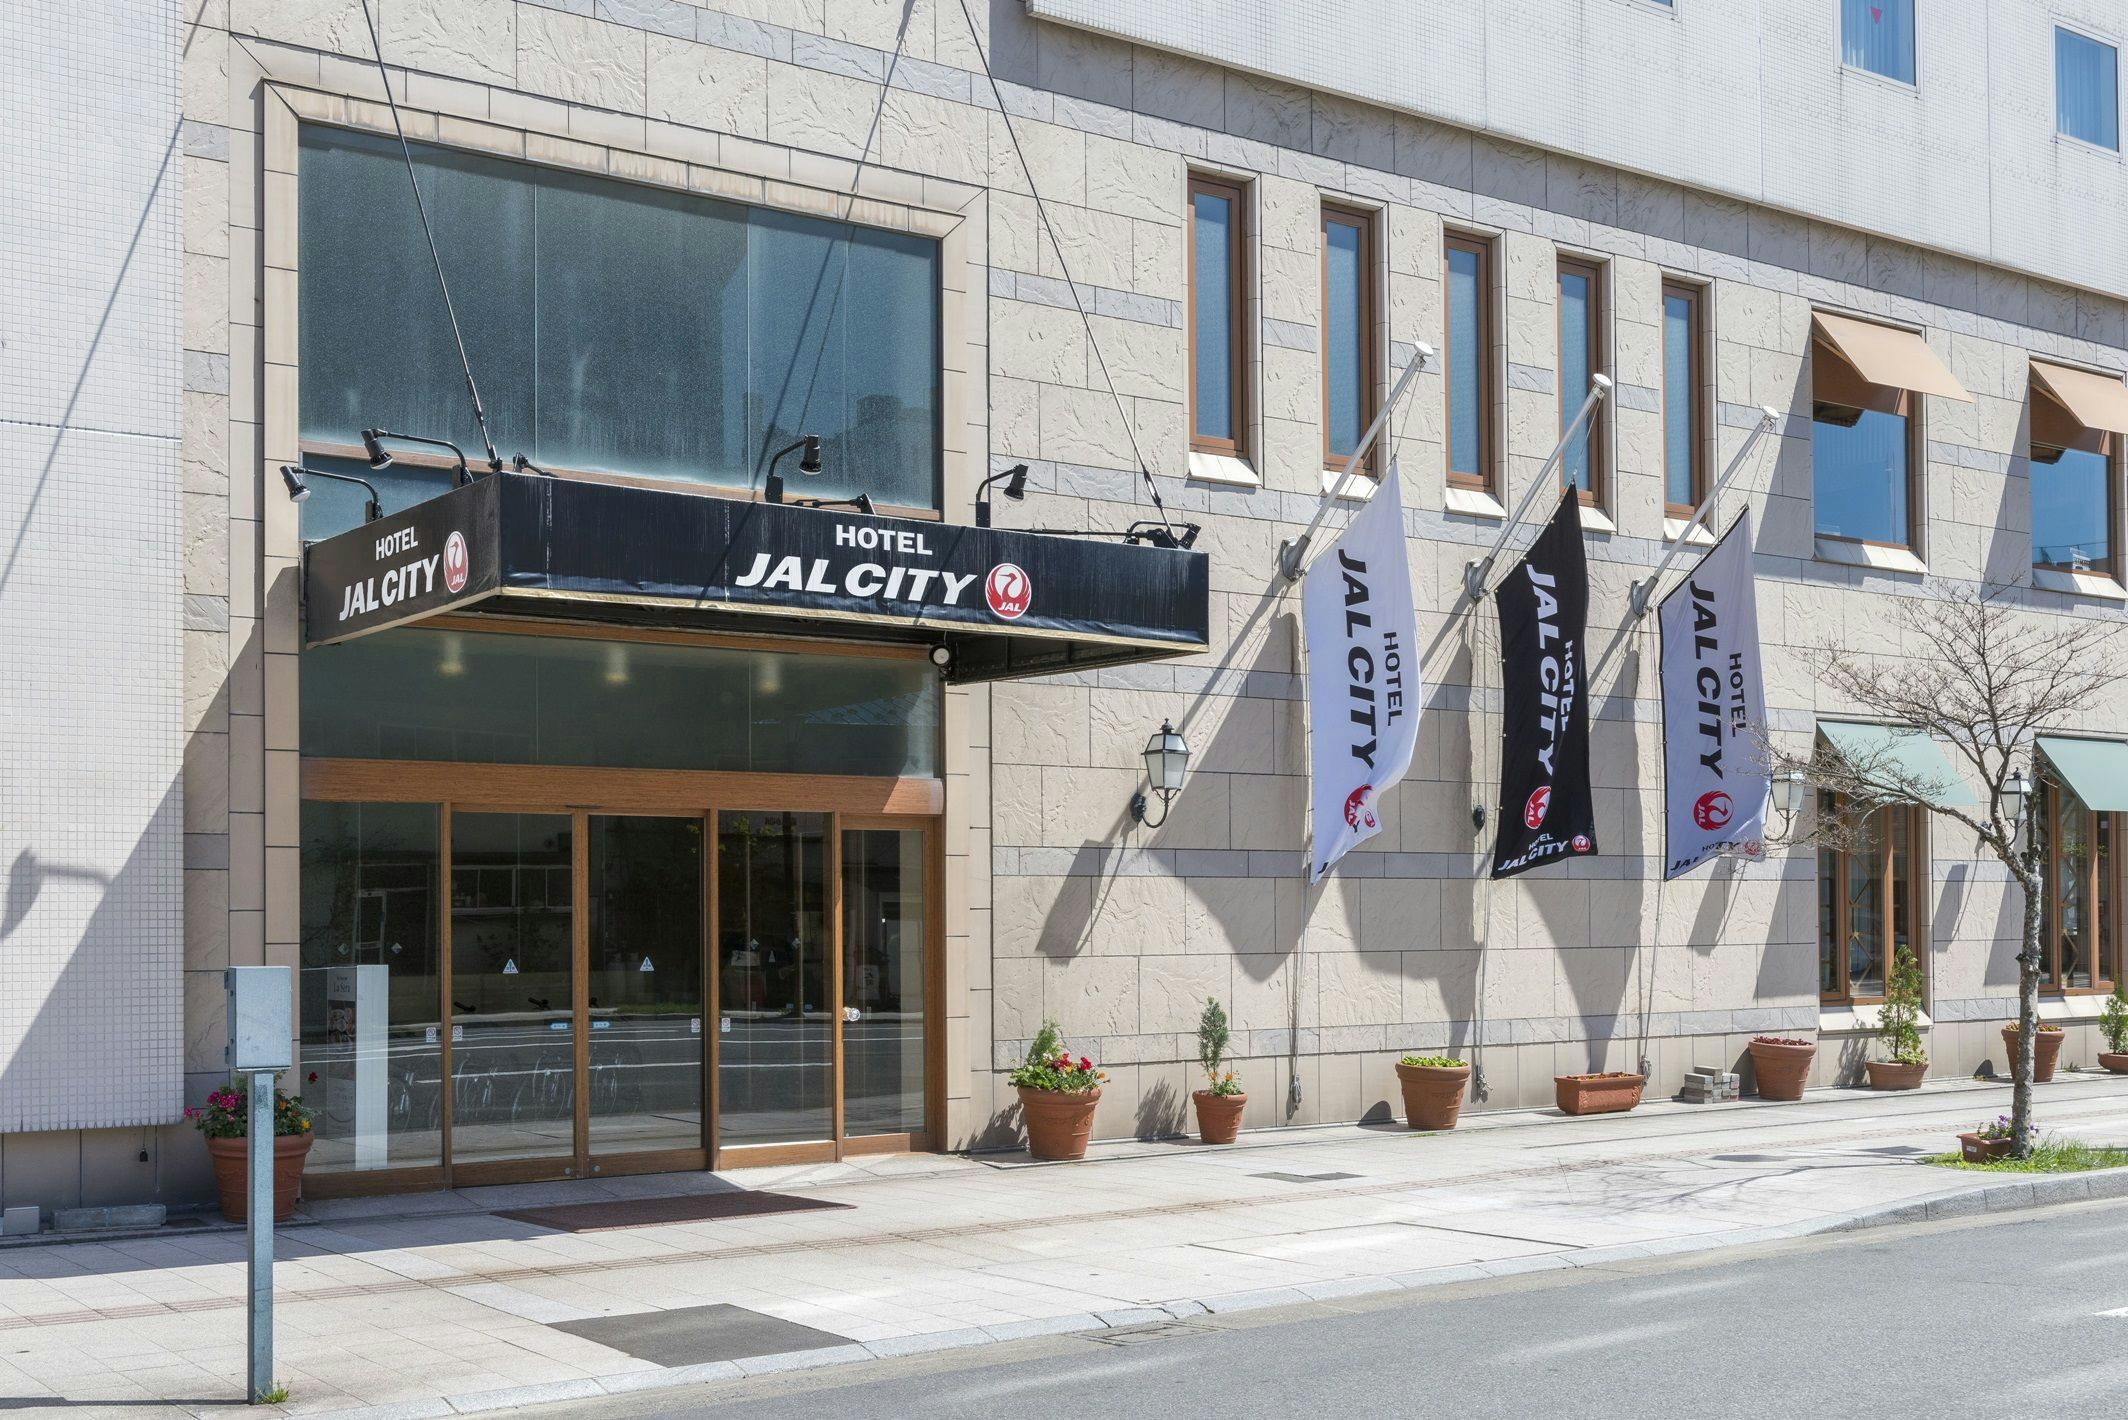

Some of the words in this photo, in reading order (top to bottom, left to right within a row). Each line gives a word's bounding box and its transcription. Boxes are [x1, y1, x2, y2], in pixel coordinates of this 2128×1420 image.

[375, 526, 418, 561] HOTEL
[835, 524, 933, 556] HOTEL
[339, 577, 378, 621] JAL
[381, 554, 440, 606] CITY
[451, 573, 464, 585] JAL
[735, 553, 836, 594] JAL
[844, 563, 978, 605] CITY
[998, 602, 1022, 612] JAL
[1338, 548, 1372, 638] JAL
[1526, 564, 1559, 650] JAL
[1689, 580, 1719, 660] JAL
[1347, 646, 1377, 770] CITY
[1383, 631, 1403, 727] HOTEL
[1560, 640, 1577, 733] HOTEL
[1728, 652, 1747, 738] HOTEL
[1538, 655, 1560, 775] CITY
[1696, 666, 1724, 779] CITY
[1348, 799, 1357, 822] JAL
[1527, 801, 1535, 824] JAL
[1698, 802, 1706, 825] JAL
[1497, 855, 1528, 871] JAL
[1528, 840, 1569, 860] CITY
